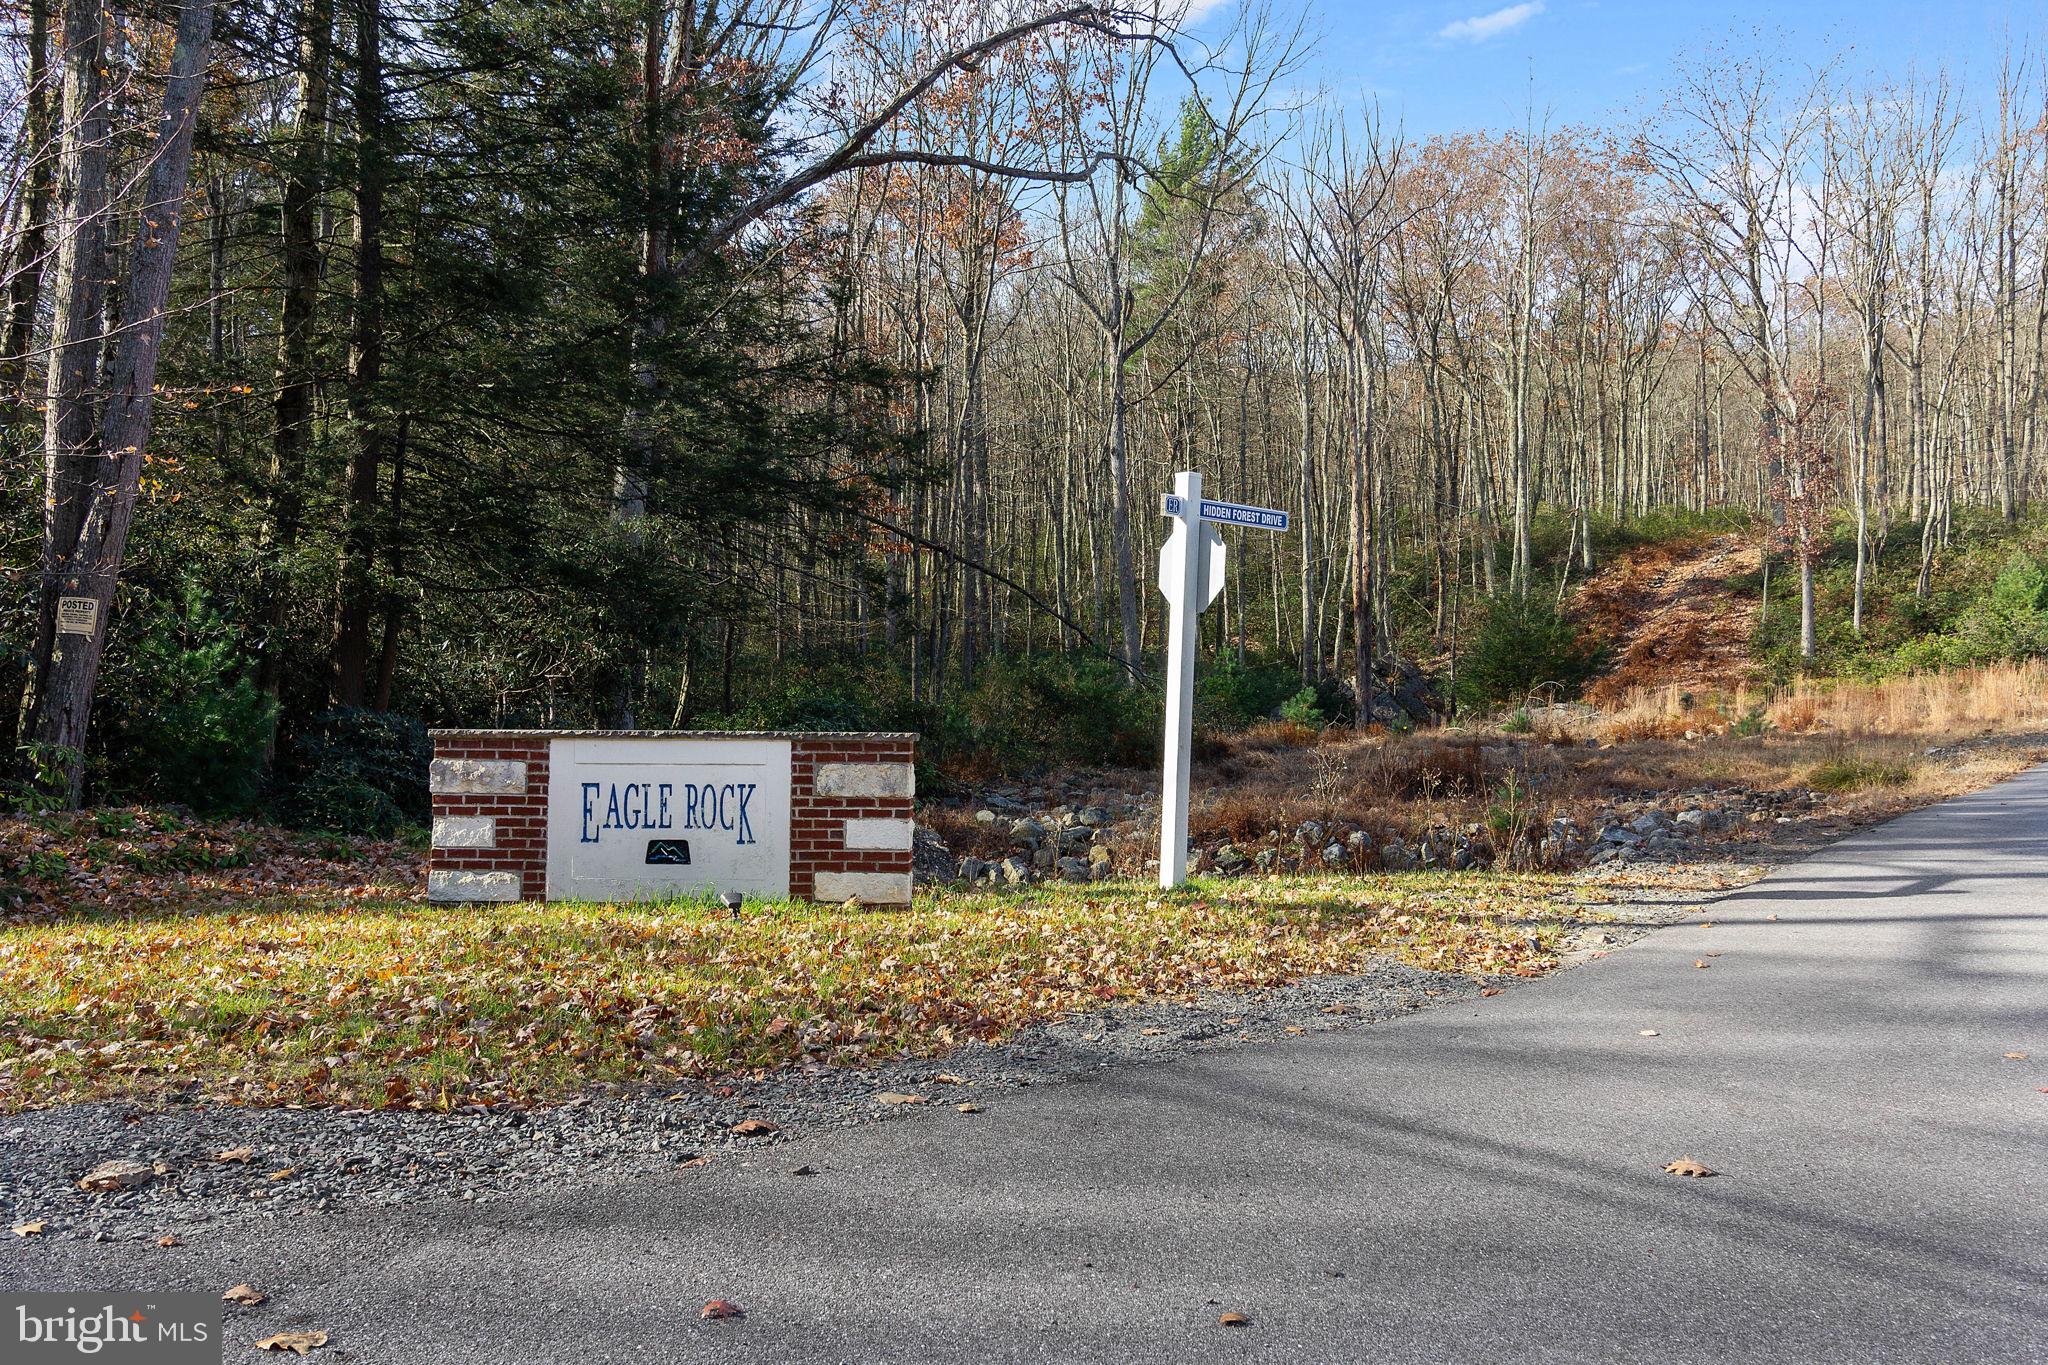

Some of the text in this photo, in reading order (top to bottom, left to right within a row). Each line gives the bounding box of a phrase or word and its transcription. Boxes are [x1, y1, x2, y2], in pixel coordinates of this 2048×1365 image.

[1168, 498, 1178, 513] ER
[1203, 505, 1283, 526] HIDDEN FOREST DRIVE
[62, 601, 94, 610] POSTED
[581, 783, 756, 844] EAGLE ROCK
